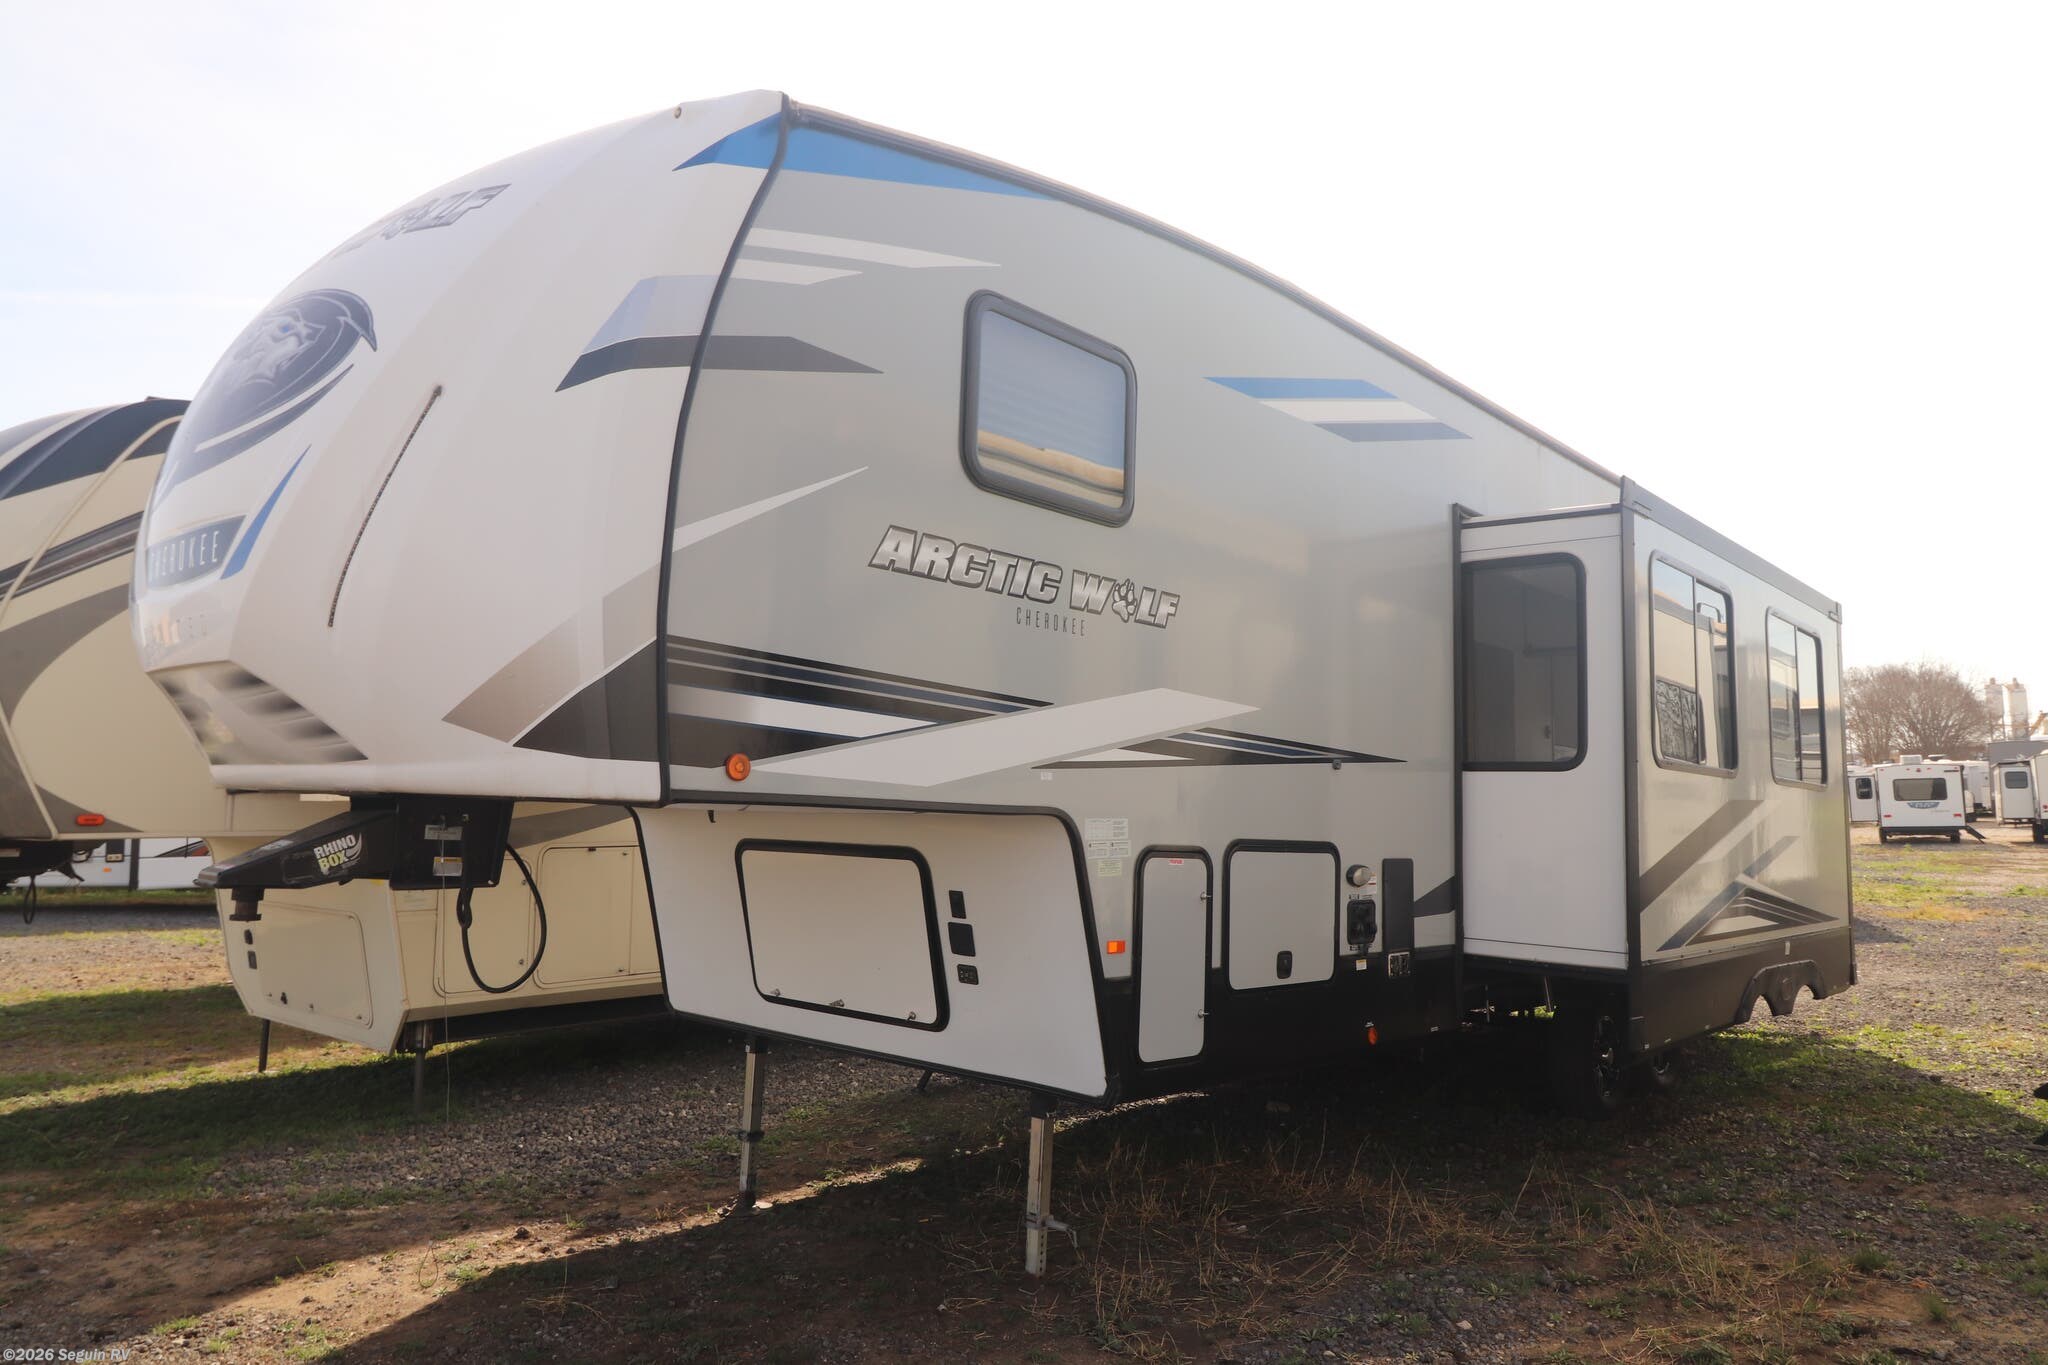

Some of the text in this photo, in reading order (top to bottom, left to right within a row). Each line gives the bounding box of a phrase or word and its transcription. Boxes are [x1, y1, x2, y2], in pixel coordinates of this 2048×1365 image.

[867, 524, 1064, 604] ARCTIC
[1015, 606, 1087, 637] CHEROKEE
[313, 834, 356, 859] RHINO
[318, 850, 349, 868] BOX
